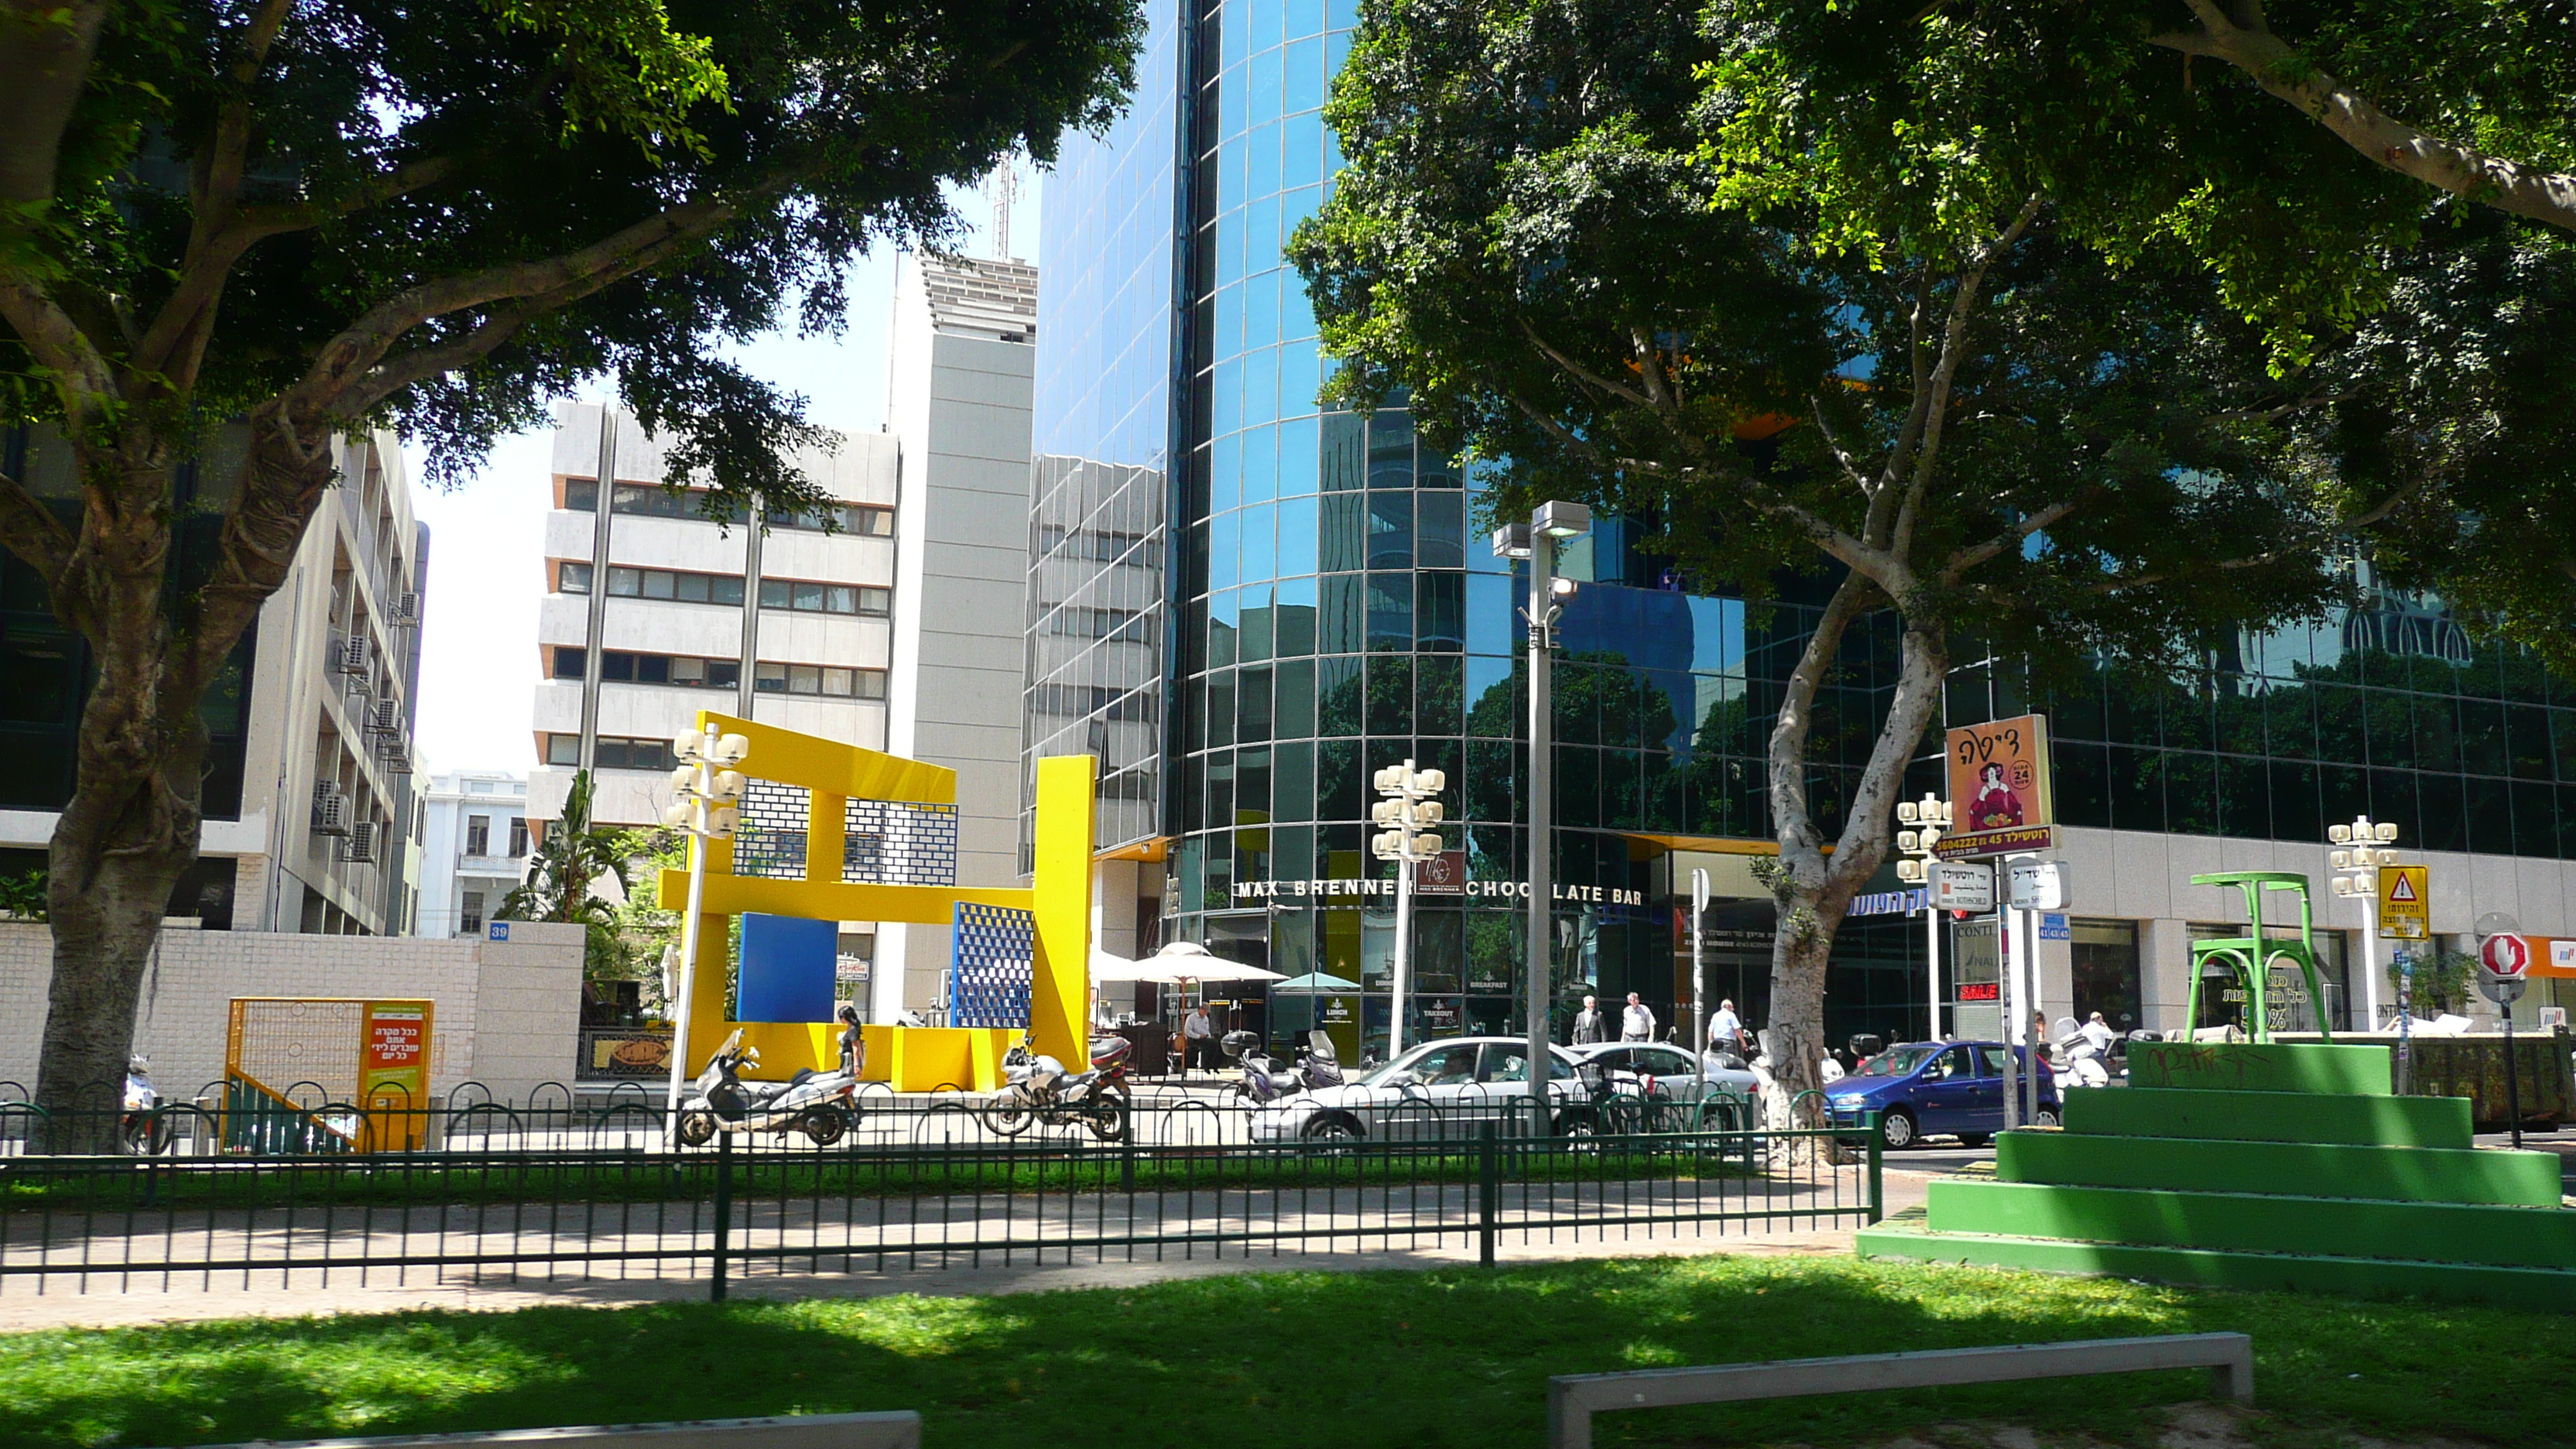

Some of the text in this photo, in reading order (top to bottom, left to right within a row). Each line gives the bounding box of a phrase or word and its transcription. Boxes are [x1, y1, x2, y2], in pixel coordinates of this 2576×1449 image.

[2014, 770, 2029, 780] 24
[1937, 828, 2050, 851] רוטשילד 45 5604222
[1942, 868, 1975, 879] רוטשילד
[1238, 881, 1279, 898] MAX
[1465, 881, 1602, 902] CHOCLATE
[1613, 888, 1642, 906] BAR
[1956, 896, 1987, 905] ROTHSCHILD
[492, 927, 507, 938] 39
[2040, 929, 2047, 937] 41
[1960, 984, 1998, 1001] SALE
[375, 1027, 418, 1036] בכל מקרה
[382, 1051, 407, 1060] כל יום
